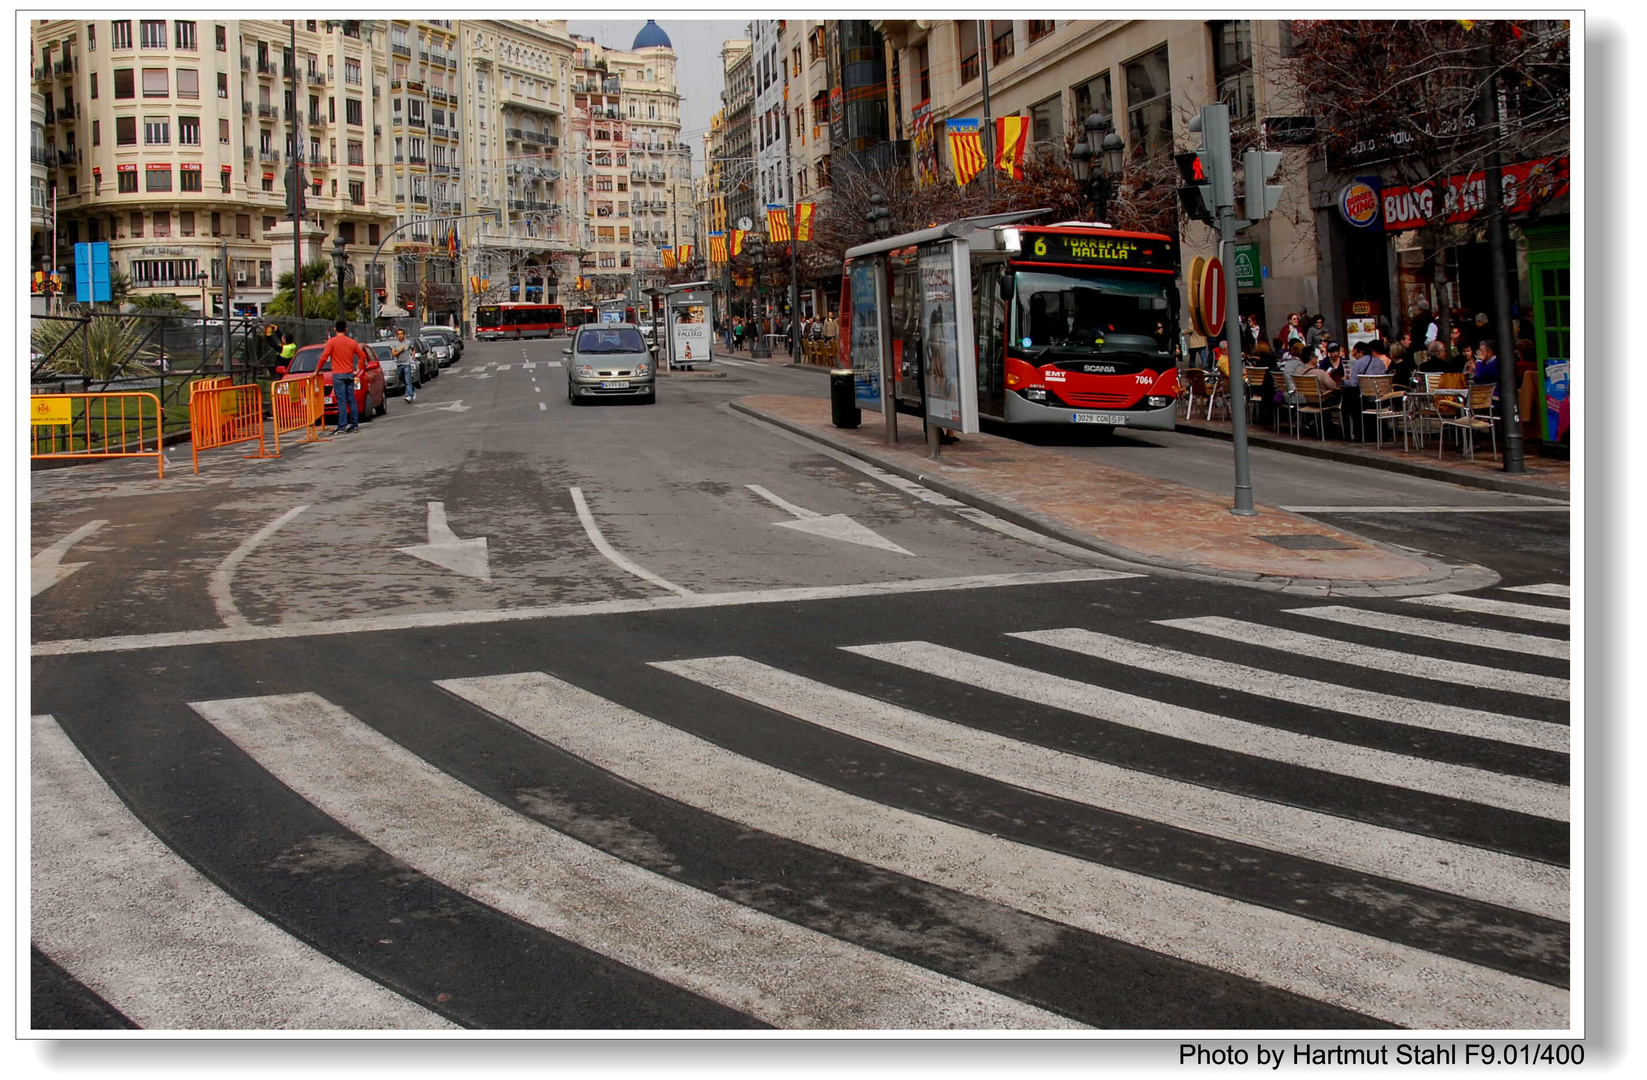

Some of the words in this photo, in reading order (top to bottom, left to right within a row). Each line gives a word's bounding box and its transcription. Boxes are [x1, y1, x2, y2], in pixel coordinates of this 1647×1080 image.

[1347, 191, 1373, 207] BURGER
[1384, 184, 1458, 223] BURGR
[1463, 174, 1518, 211] KIG
[1348, 198, 1375, 217] KING
[1034, 236, 1047, 256] 6
[1063, 237, 1137, 250] TORREFIEL
[1072, 248, 1128, 259] MALILLA
[1045, 370, 1066, 378] EMT
[1084, 365, 1115, 373] SCANIA
[1135, 375, 1153, 385] 7064
[1077, 414, 1094, 422] 3029
